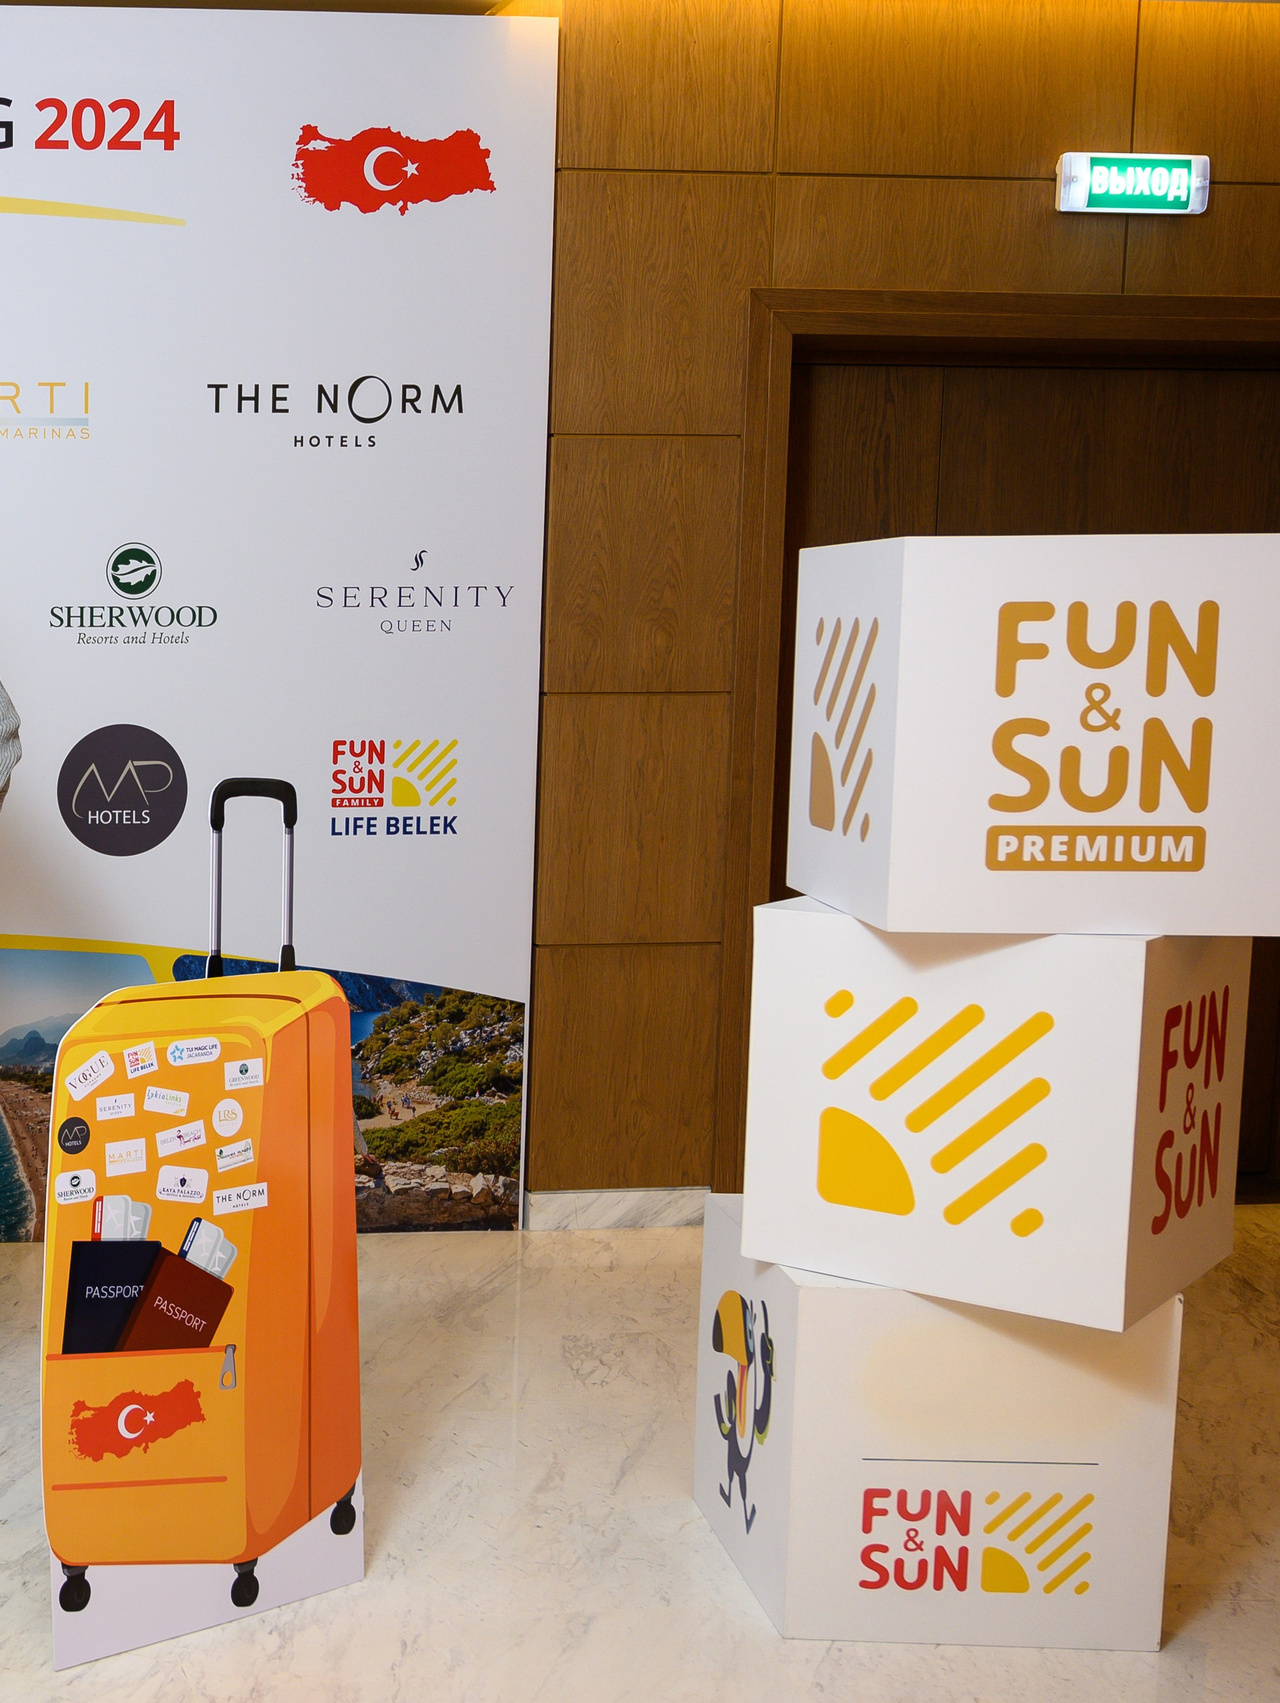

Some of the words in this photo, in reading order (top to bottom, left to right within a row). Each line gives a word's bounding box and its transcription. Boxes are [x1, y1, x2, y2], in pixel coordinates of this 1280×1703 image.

[34, 97, 181, 151] 2024
[1091, 165, 1189, 202] ВЫХОД
[207, 384, 289, 414] THE
[317, 375, 464, 424] NORM
[294, 436, 377, 447] HOTELS
[316, 585, 515, 608] SERENITY
[49, 605, 218, 628] SHERWOOD
[380, 619, 452, 634] QUEEN
[77, 632, 119, 645] Resorts
[123, 631, 147, 644] and
[151, 632, 190, 645] Hotels
[995, 600, 1220, 698] FUN
[1079, 682, 1121, 733] &
[332, 739, 386, 765] FUN
[352, 760, 364, 774] &
[988, 717, 1213, 813] SUN
[331, 769, 385, 794] SUN
[336, 798, 380, 807] FAMILY
[88, 810, 151, 825] HOTELS
[331, 817, 378, 836] LIFE
[386, 816, 458, 835] BELEK
[996, 834, 1194, 863] PREMIUM
[1159, 985, 1229, 1113] FUN
[68, 1055, 109, 1090] VOGUE
[130, 1066, 140, 1074] LIFE
[99, 1103, 132, 1112] SERENITY
[218, 1109, 238, 1123] LRS
[1182, 1081, 1197, 1134] &
[108, 1149, 143, 1161] MARTI
[1151, 1101, 1222, 1236] SUN
[57, 1187, 94, 1199] SHERWOOD
[216, 1194, 232, 1204] THE
[236, 1188, 265, 1201] NORM
[154, 1296, 207, 1332] PASSPORT
[861, 1487, 972, 1536] FUN
[903, 1527, 924, 1552] &
[858, 1543, 969, 1592] SUN
